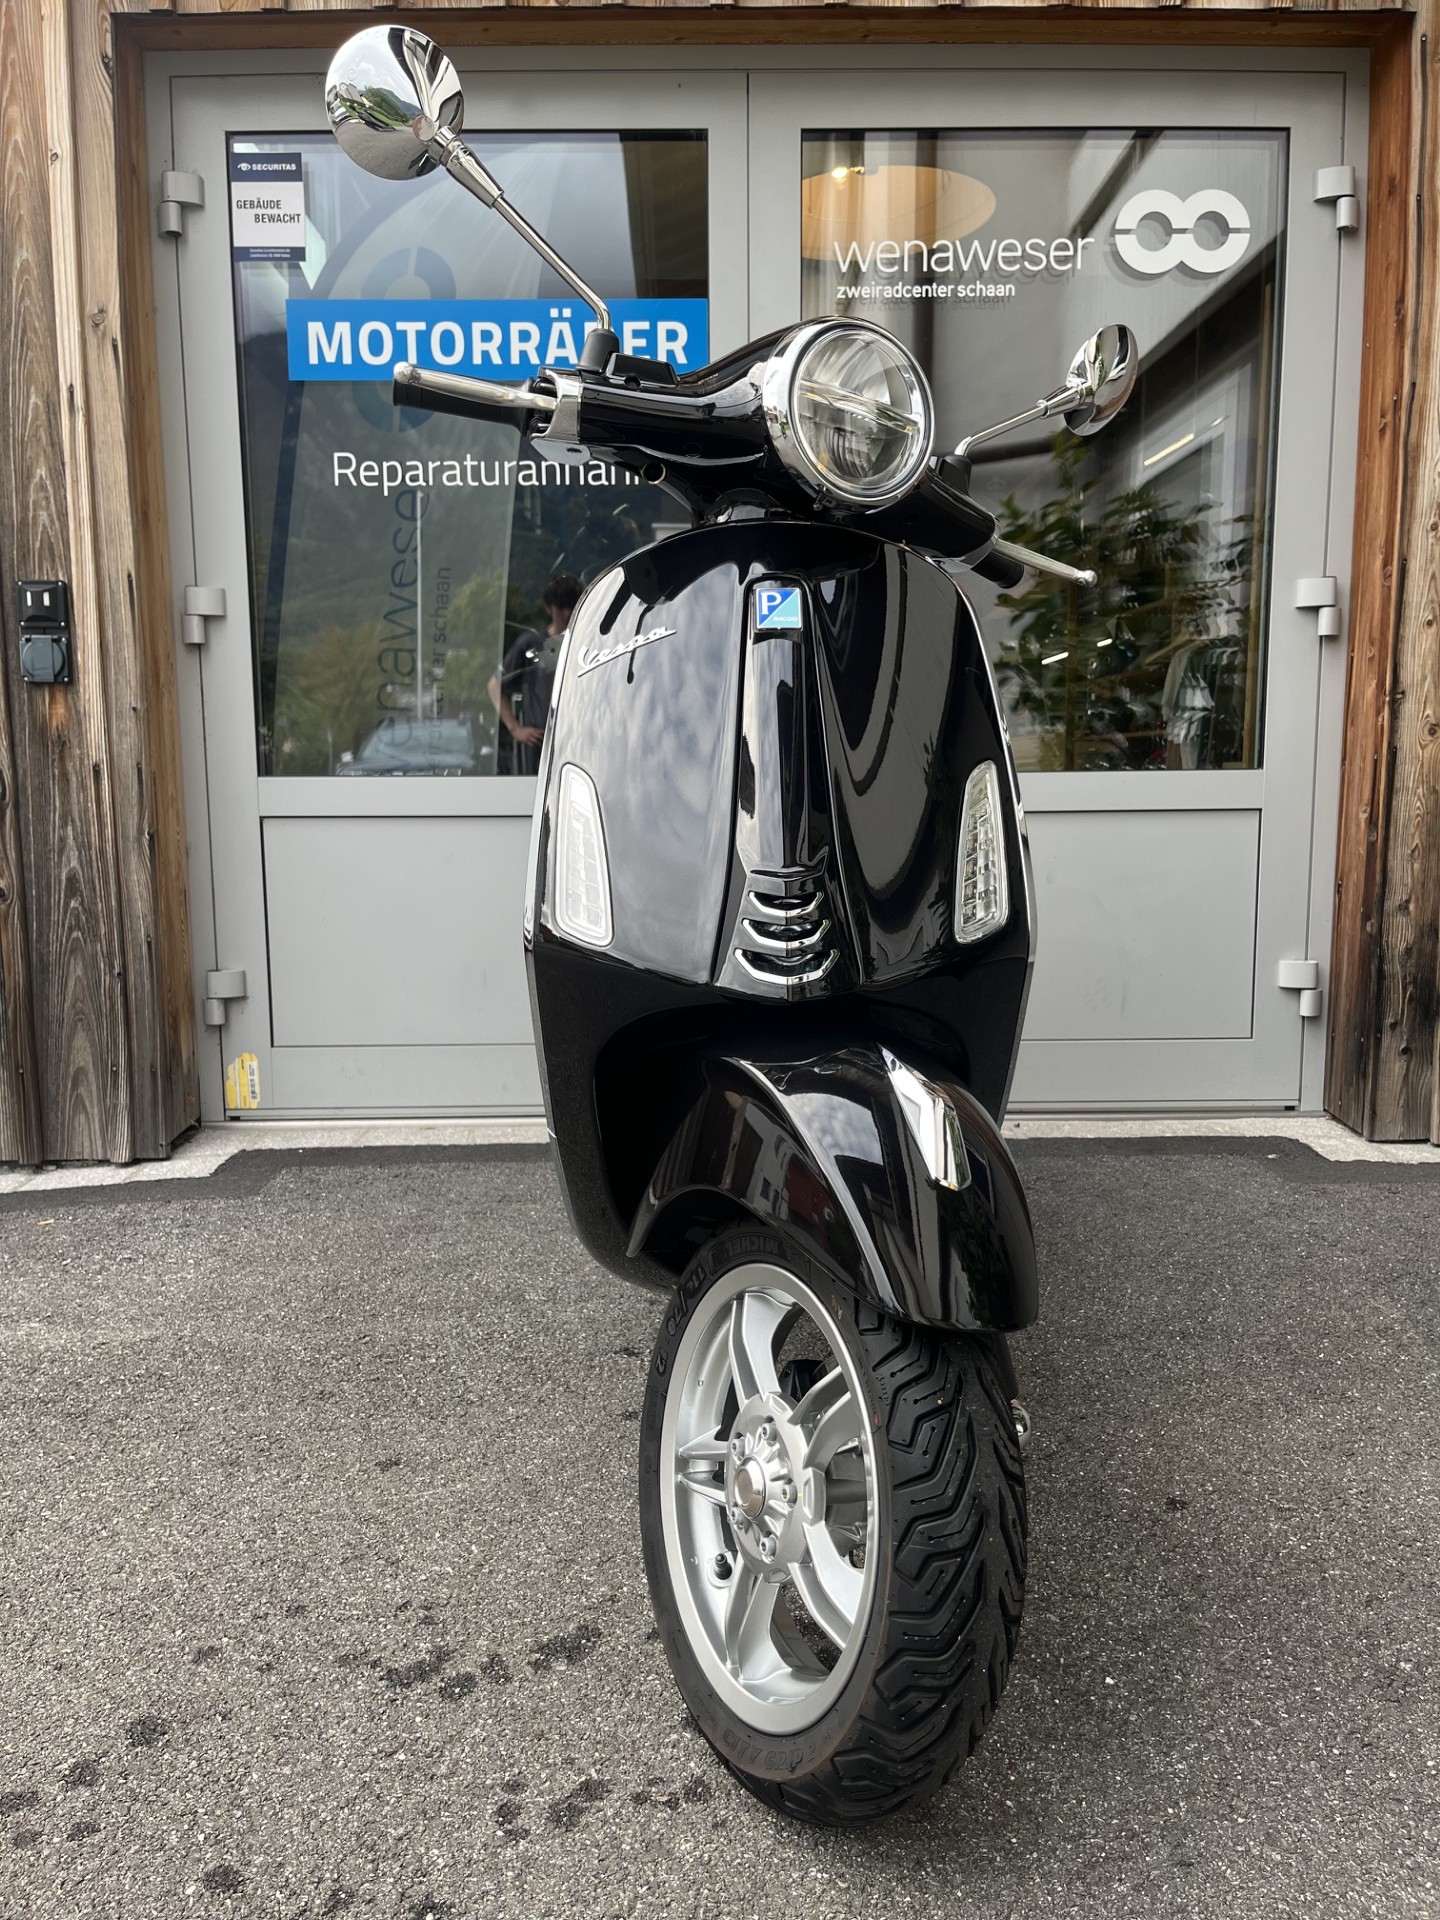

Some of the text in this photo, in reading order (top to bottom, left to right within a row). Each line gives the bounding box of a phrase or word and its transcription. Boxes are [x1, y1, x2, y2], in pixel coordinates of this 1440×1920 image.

[251, 163, 297, 171] SECURITAS
[236, 197, 282, 210] GEBÄUDE
[254, 213, 301, 224] BEWACHT
[833, 236, 1096, 273] wenaweser
[836, 280, 1016, 299] zweiradcenter schaan
[307, 307, 689, 366] MOTORRÄER
[577, 626, 677, 677] Vespa
